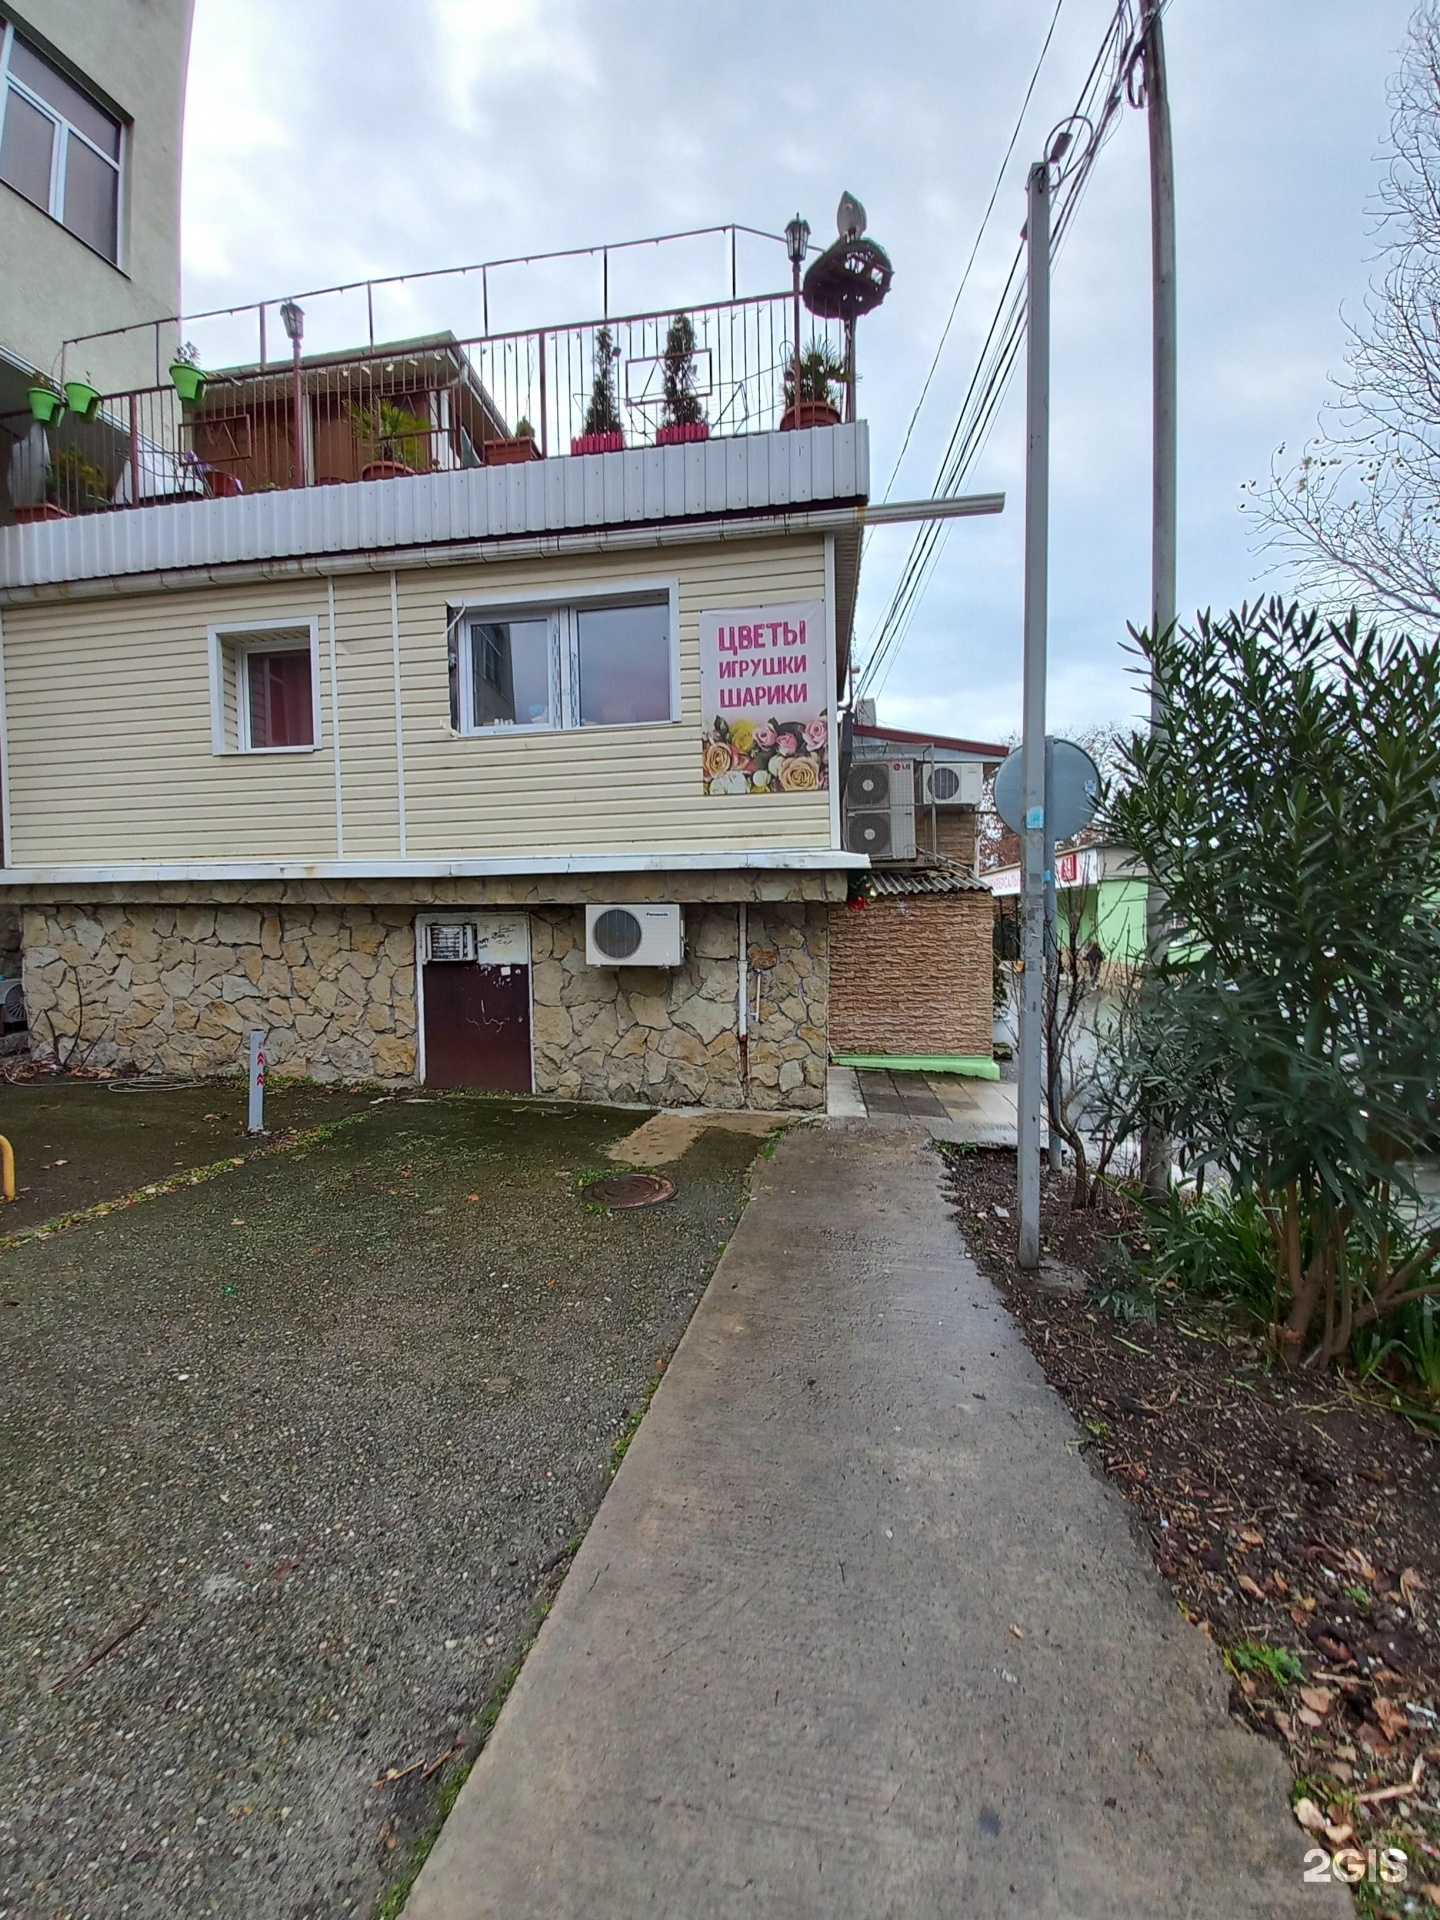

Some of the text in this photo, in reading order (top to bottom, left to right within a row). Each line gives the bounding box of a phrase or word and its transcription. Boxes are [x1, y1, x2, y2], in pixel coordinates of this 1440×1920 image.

[718, 620, 807, 656] ЦВЕТЫ
[719, 655, 807, 679] ИГРУШКИ
[719, 683, 808, 708] ШАРИКИ
